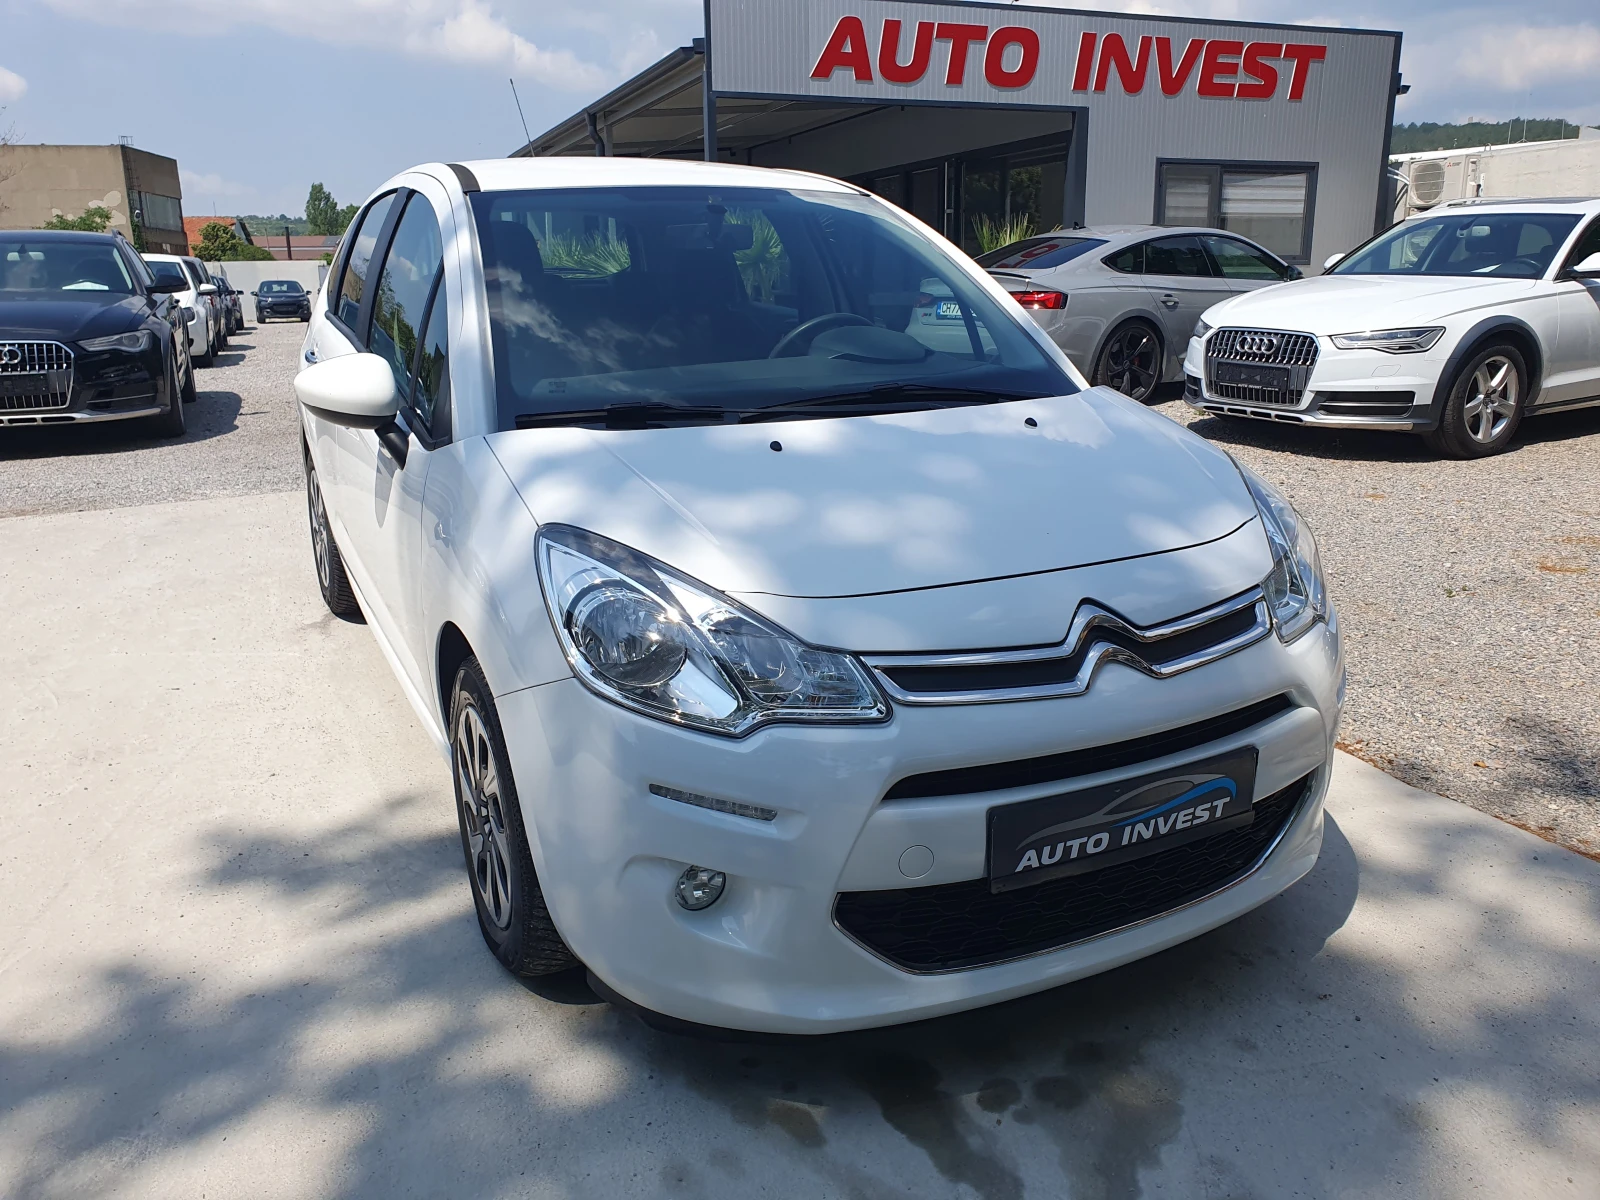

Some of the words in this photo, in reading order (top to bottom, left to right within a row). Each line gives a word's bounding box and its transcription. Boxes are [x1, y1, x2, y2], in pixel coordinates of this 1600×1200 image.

[809, 15, 1040, 88] AUTO
[1072, 31, 1327, 100] INVEST
[1015, 833, 1109, 872] AUTO
[1121, 797, 1231, 845] INVEST
